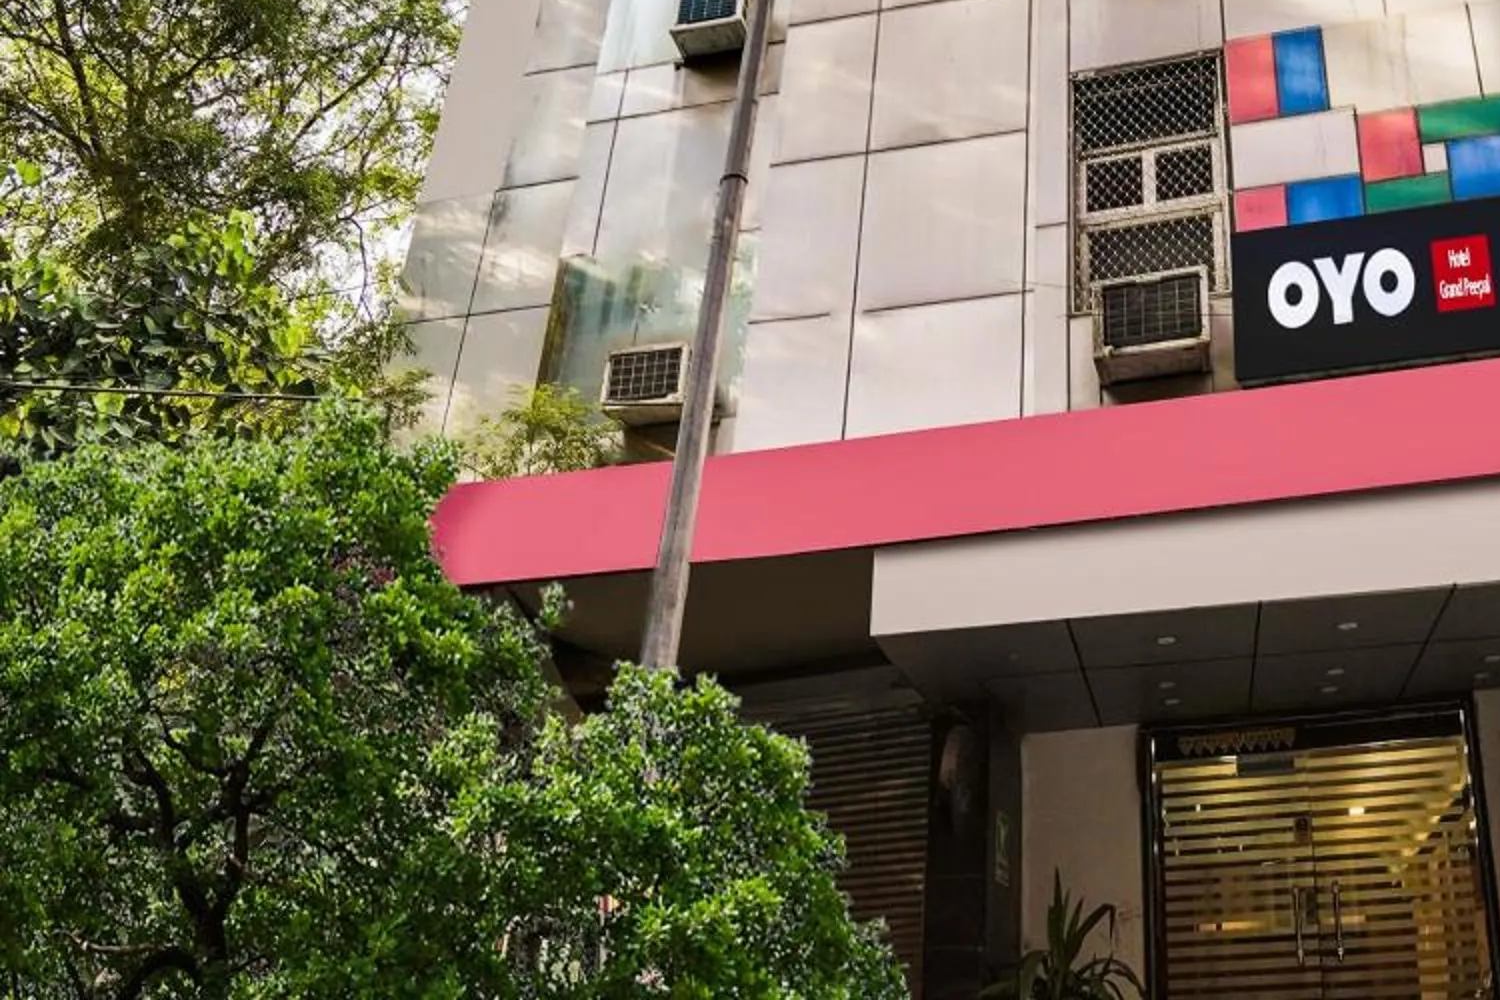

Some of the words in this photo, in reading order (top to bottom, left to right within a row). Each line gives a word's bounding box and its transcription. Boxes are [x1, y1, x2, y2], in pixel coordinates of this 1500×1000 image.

[1447, 247, 1471, 269] Hotel
[1268, 247, 1416, 329] OYO
[1440, 277, 1463, 299] Grand
[1463, 273, 1491, 301] Peepal
